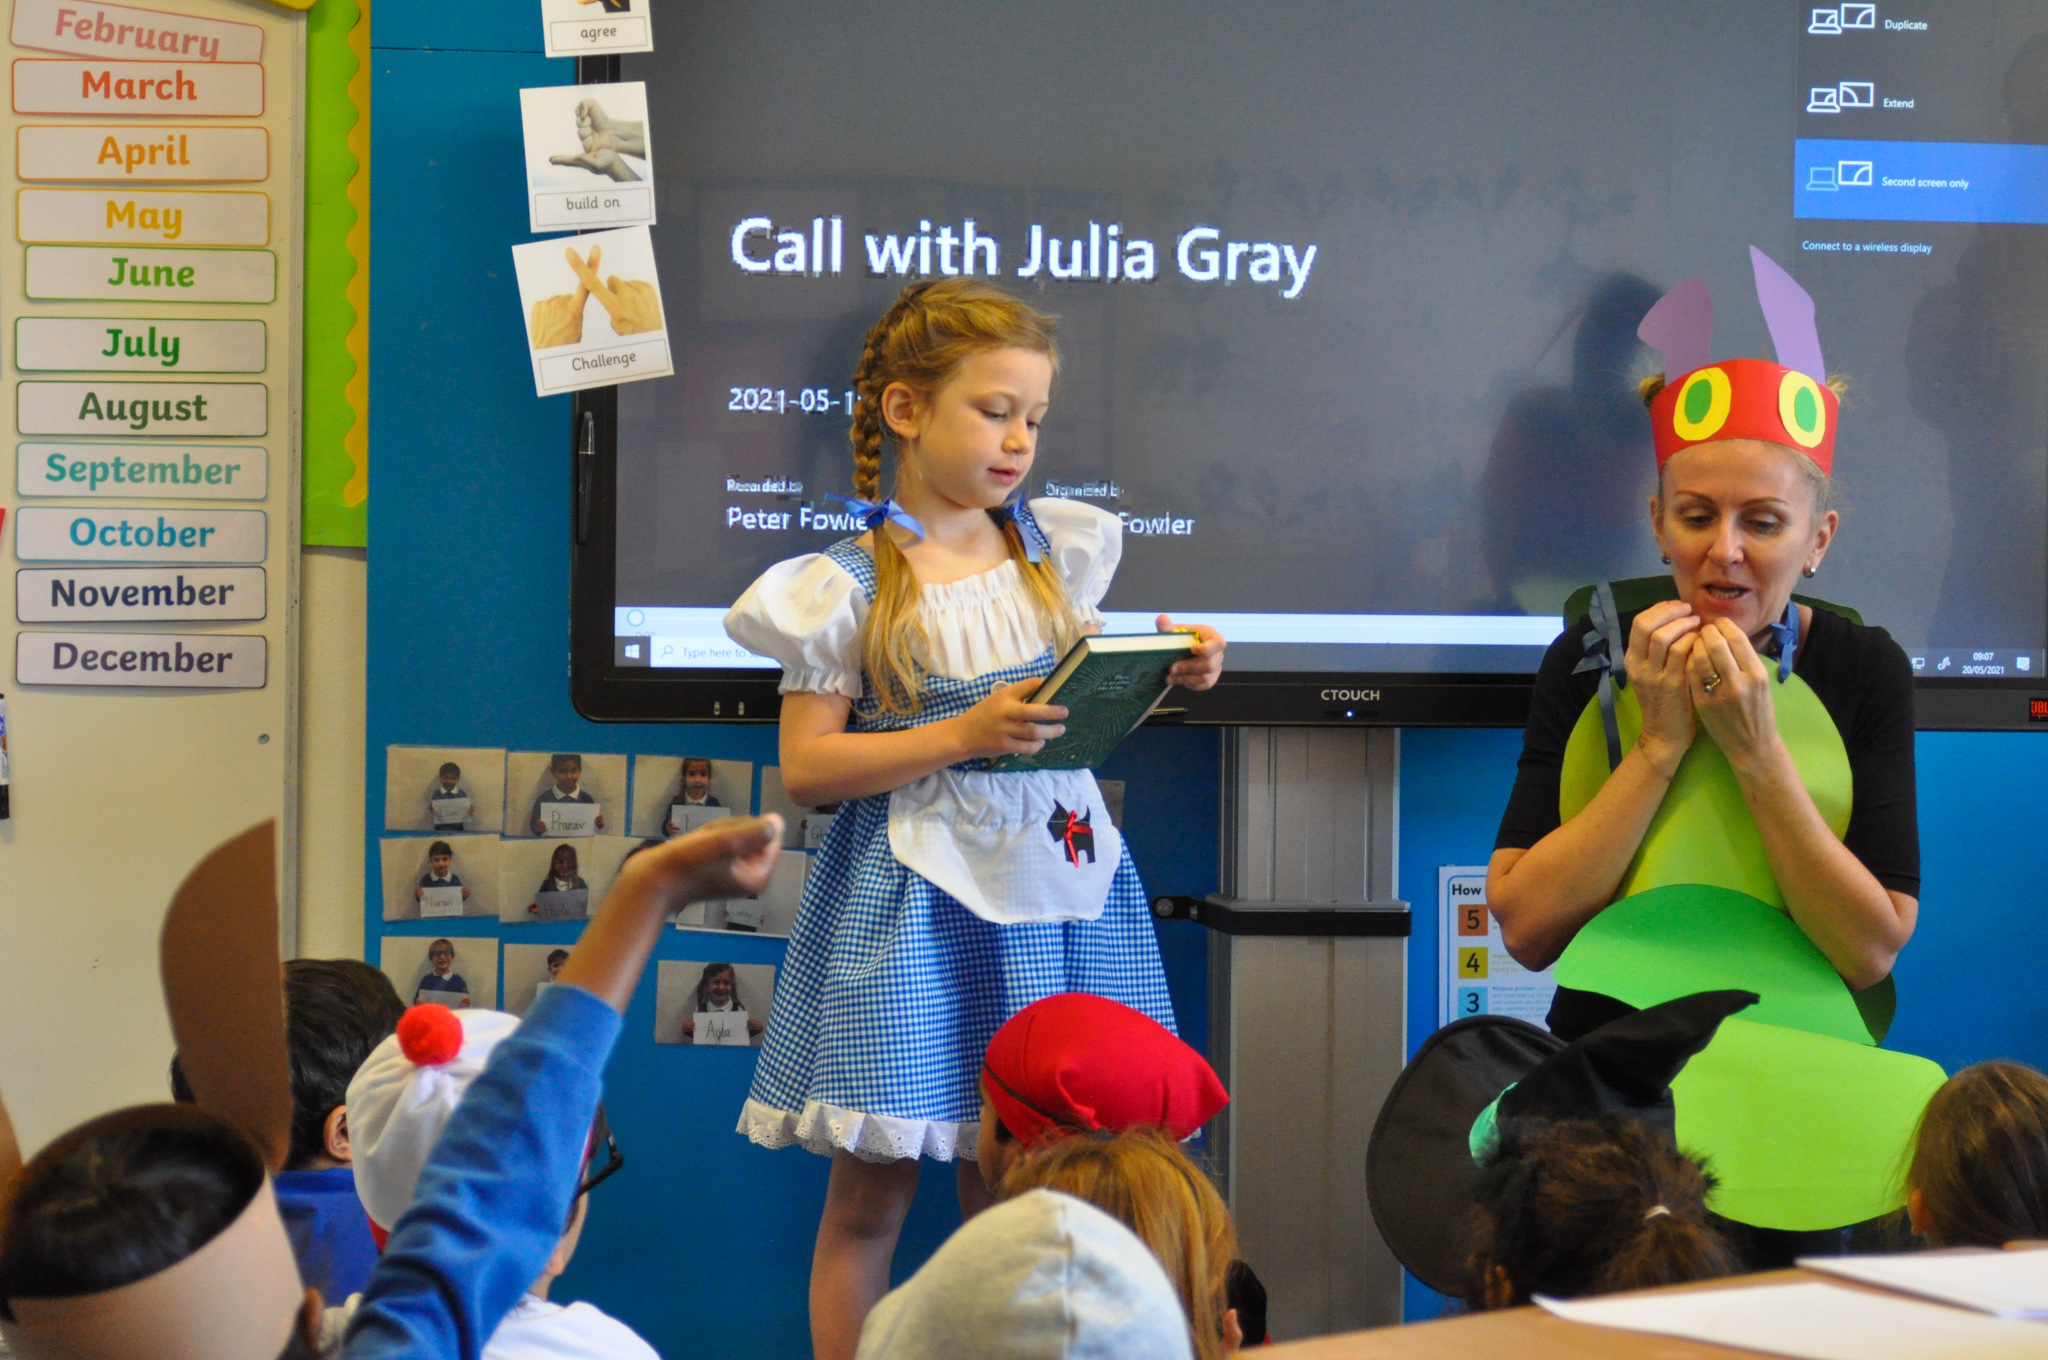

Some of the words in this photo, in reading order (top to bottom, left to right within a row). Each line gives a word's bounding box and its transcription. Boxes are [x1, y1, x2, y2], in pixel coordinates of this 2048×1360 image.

[55, 8, 220, 61] February
[580, 25, 617, 41] agree
[1884, 20, 1928, 31] Duplicate
[81, 69, 197, 101] March
[1883, 98, 1915, 109] Extend
[97, 134, 190, 174] April
[1882, 177, 1916, 188] Second
[1917, 179, 1947, 188] screen
[1949, 179, 1970, 191] only
[565, 196, 599, 211] build
[603, 199, 620, 209] on
[105, 200, 183, 239] May
[731, 217, 842, 275] Call
[864, 220, 998, 277] with
[1017, 223, 1155, 281] Julia
[1176, 227, 1317, 299] Gray
[1802, 241, 1841, 252] Connect
[1843, 242, 1853, 252] to
[1855, 244, 1861, 252] a
[1862, 242, 1899, 253] wireless
[1901, 243, 1933, 255] display
[107, 257, 195, 288] June
[102, 326, 180, 367] July
[571, 351, 637, 373] Challenge
[78, 391, 208, 430] August
[728, 387, 862, 416] 2021-05-1
[45, 453, 241, 491] September
[727, 505, 792, 530] Peter
[800, 505, 869, 531] Fowle
[69, 517, 215, 548] October
[51, 575, 235, 608] November
[53, 641, 233, 673] December
[683, 647, 707, 660] Type
[709, 647, 732, 658] here
[735, 648, 746, 658] to
[1973, 652, 1994, 661] 09:07
[1962, 665, 2005, 675] 20/05/2021
[1320, 689, 1380, 701] CTOUCH
[2031, 700, 2048, 714] JBL
[1451, 883, 1482, 896] How
[1466, 909, 1480, 930] 5
[1466, 952, 1480, 973] 4
[1466, 992, 1480, 1013] 3
